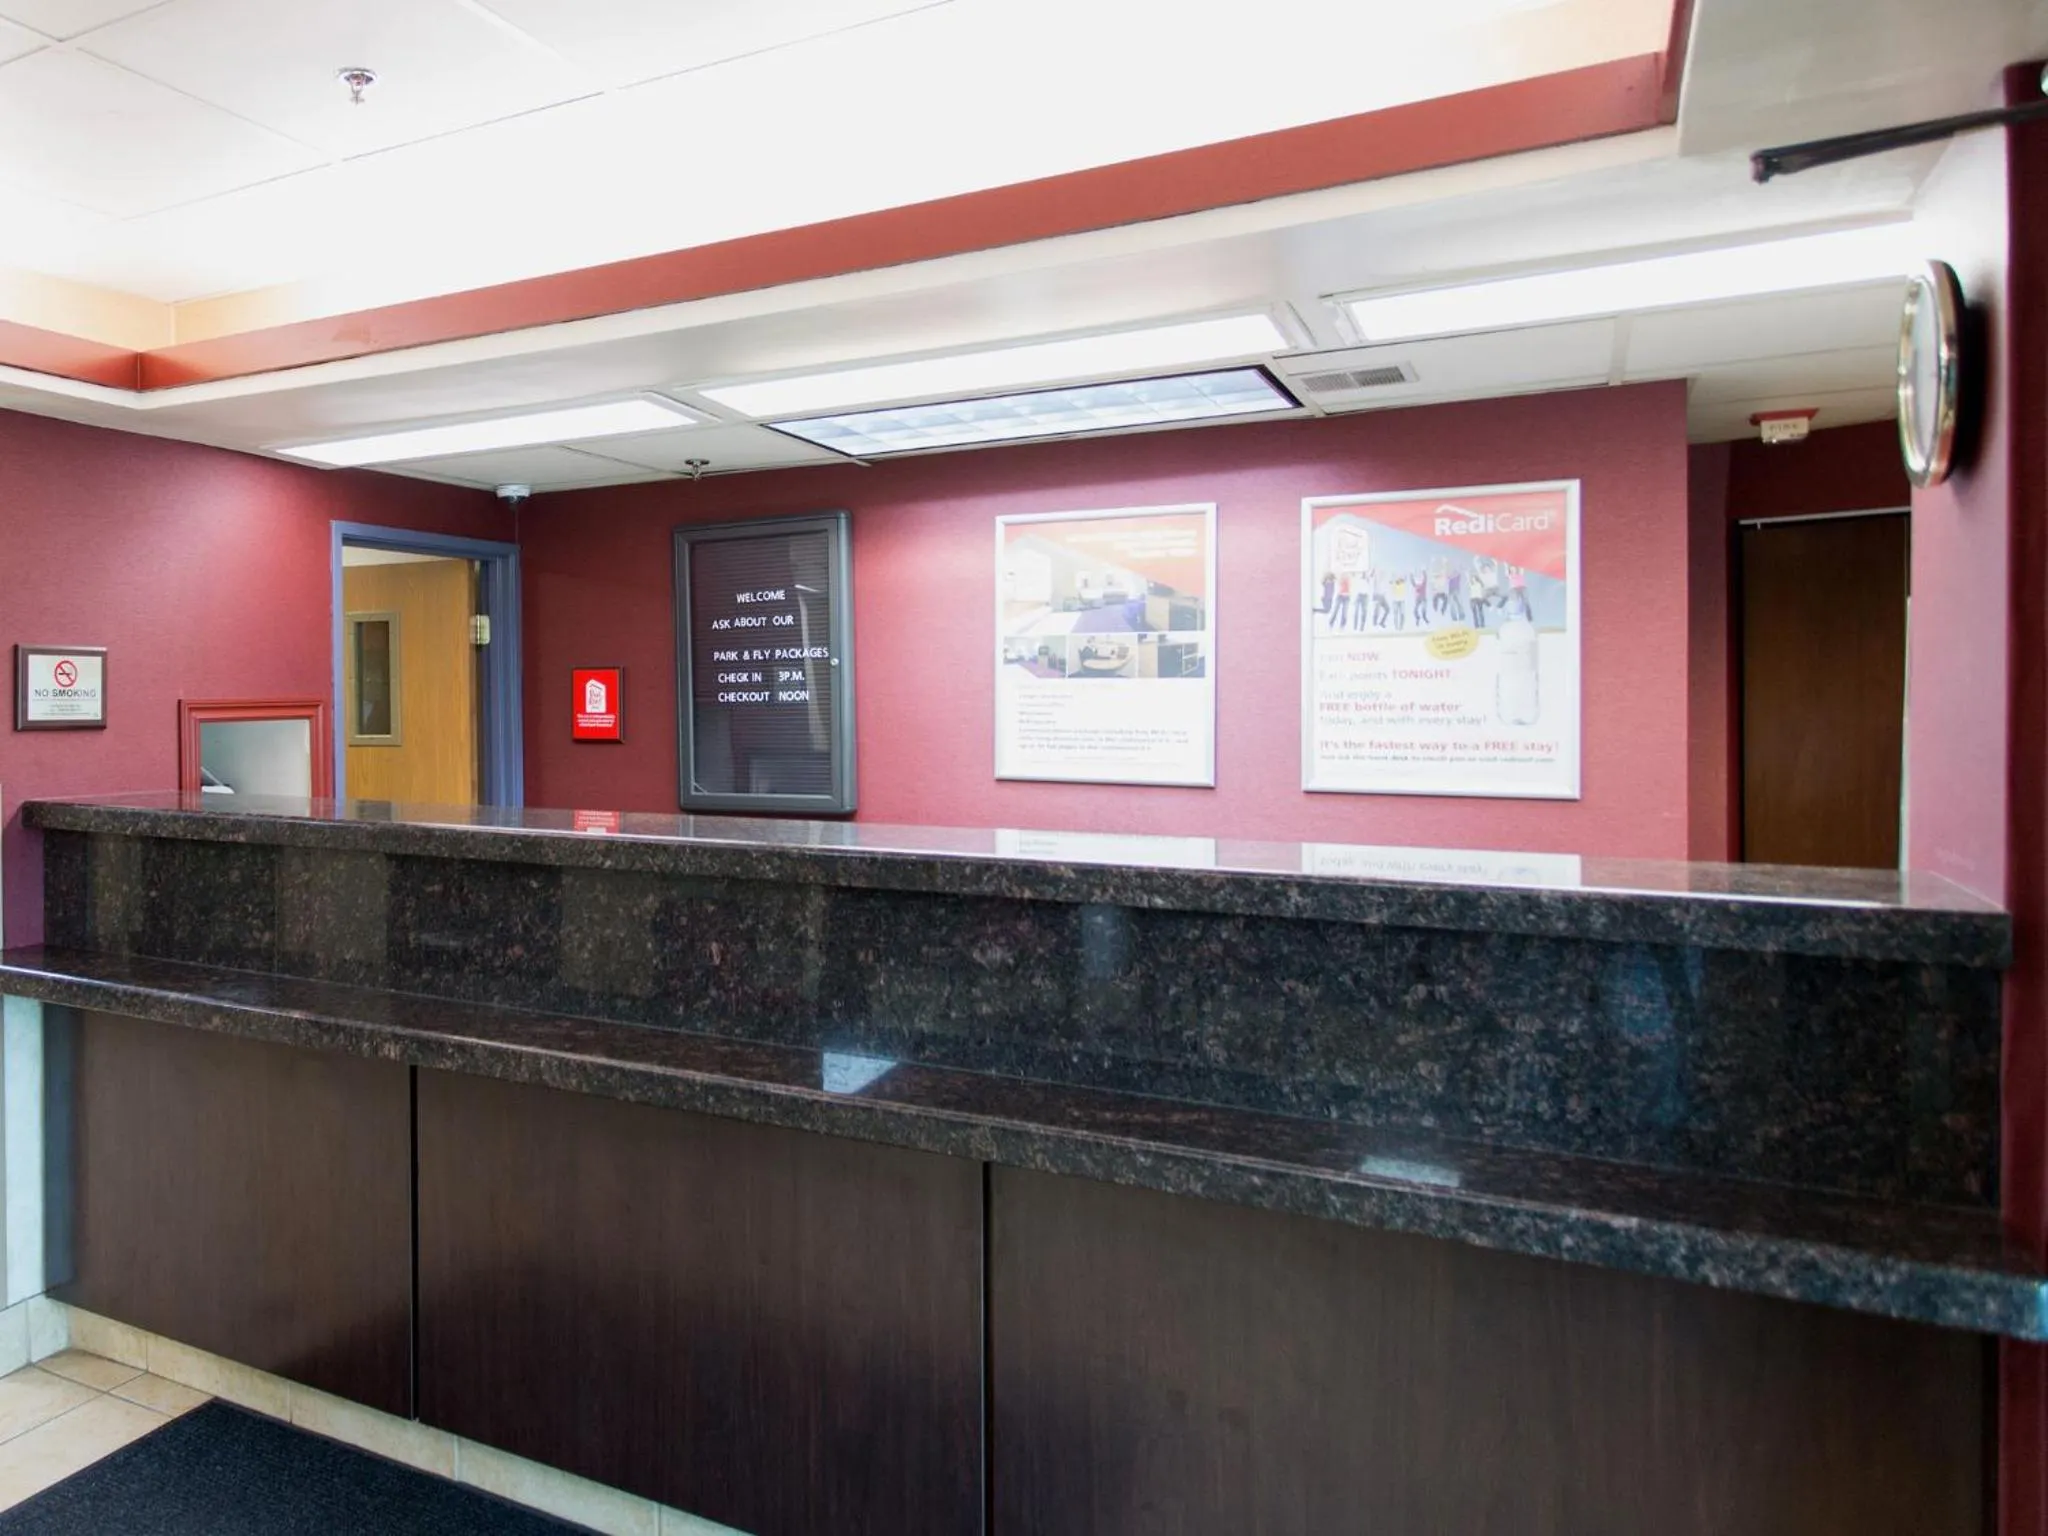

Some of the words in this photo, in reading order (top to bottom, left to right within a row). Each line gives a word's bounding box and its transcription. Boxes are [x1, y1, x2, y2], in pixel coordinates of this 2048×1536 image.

[736, 590, 786, 603] WELCOME
[712, 619, 731, 630] ASK
[734, 616, 767, 628] ABOUT
[772, 615, 794, 626] OUR
[713, 651, 738, 662] PARK
[742, 651, 750, 661] &
[753, 649, 771, 660] FLY
[775, 647, 829, 660] PACKAGES
[751, 672, 762, 682] IN
[1392, 668, 1451, 681] TONIGHT
[34, 688, 49, 697] NO
[52, 688, 96, 697] SMOKING
[718, 691, 769, 702] CHECKOUT
[779, 690, 809, 701] NOON
[1319, 702, 1349, 712] FREE
[1400, 702, 1416, 712] of
[1419, 703, 1461, 713] water
[1419, 742, 1447, 753] way
[1484, 741, 1518, 752] FREE
